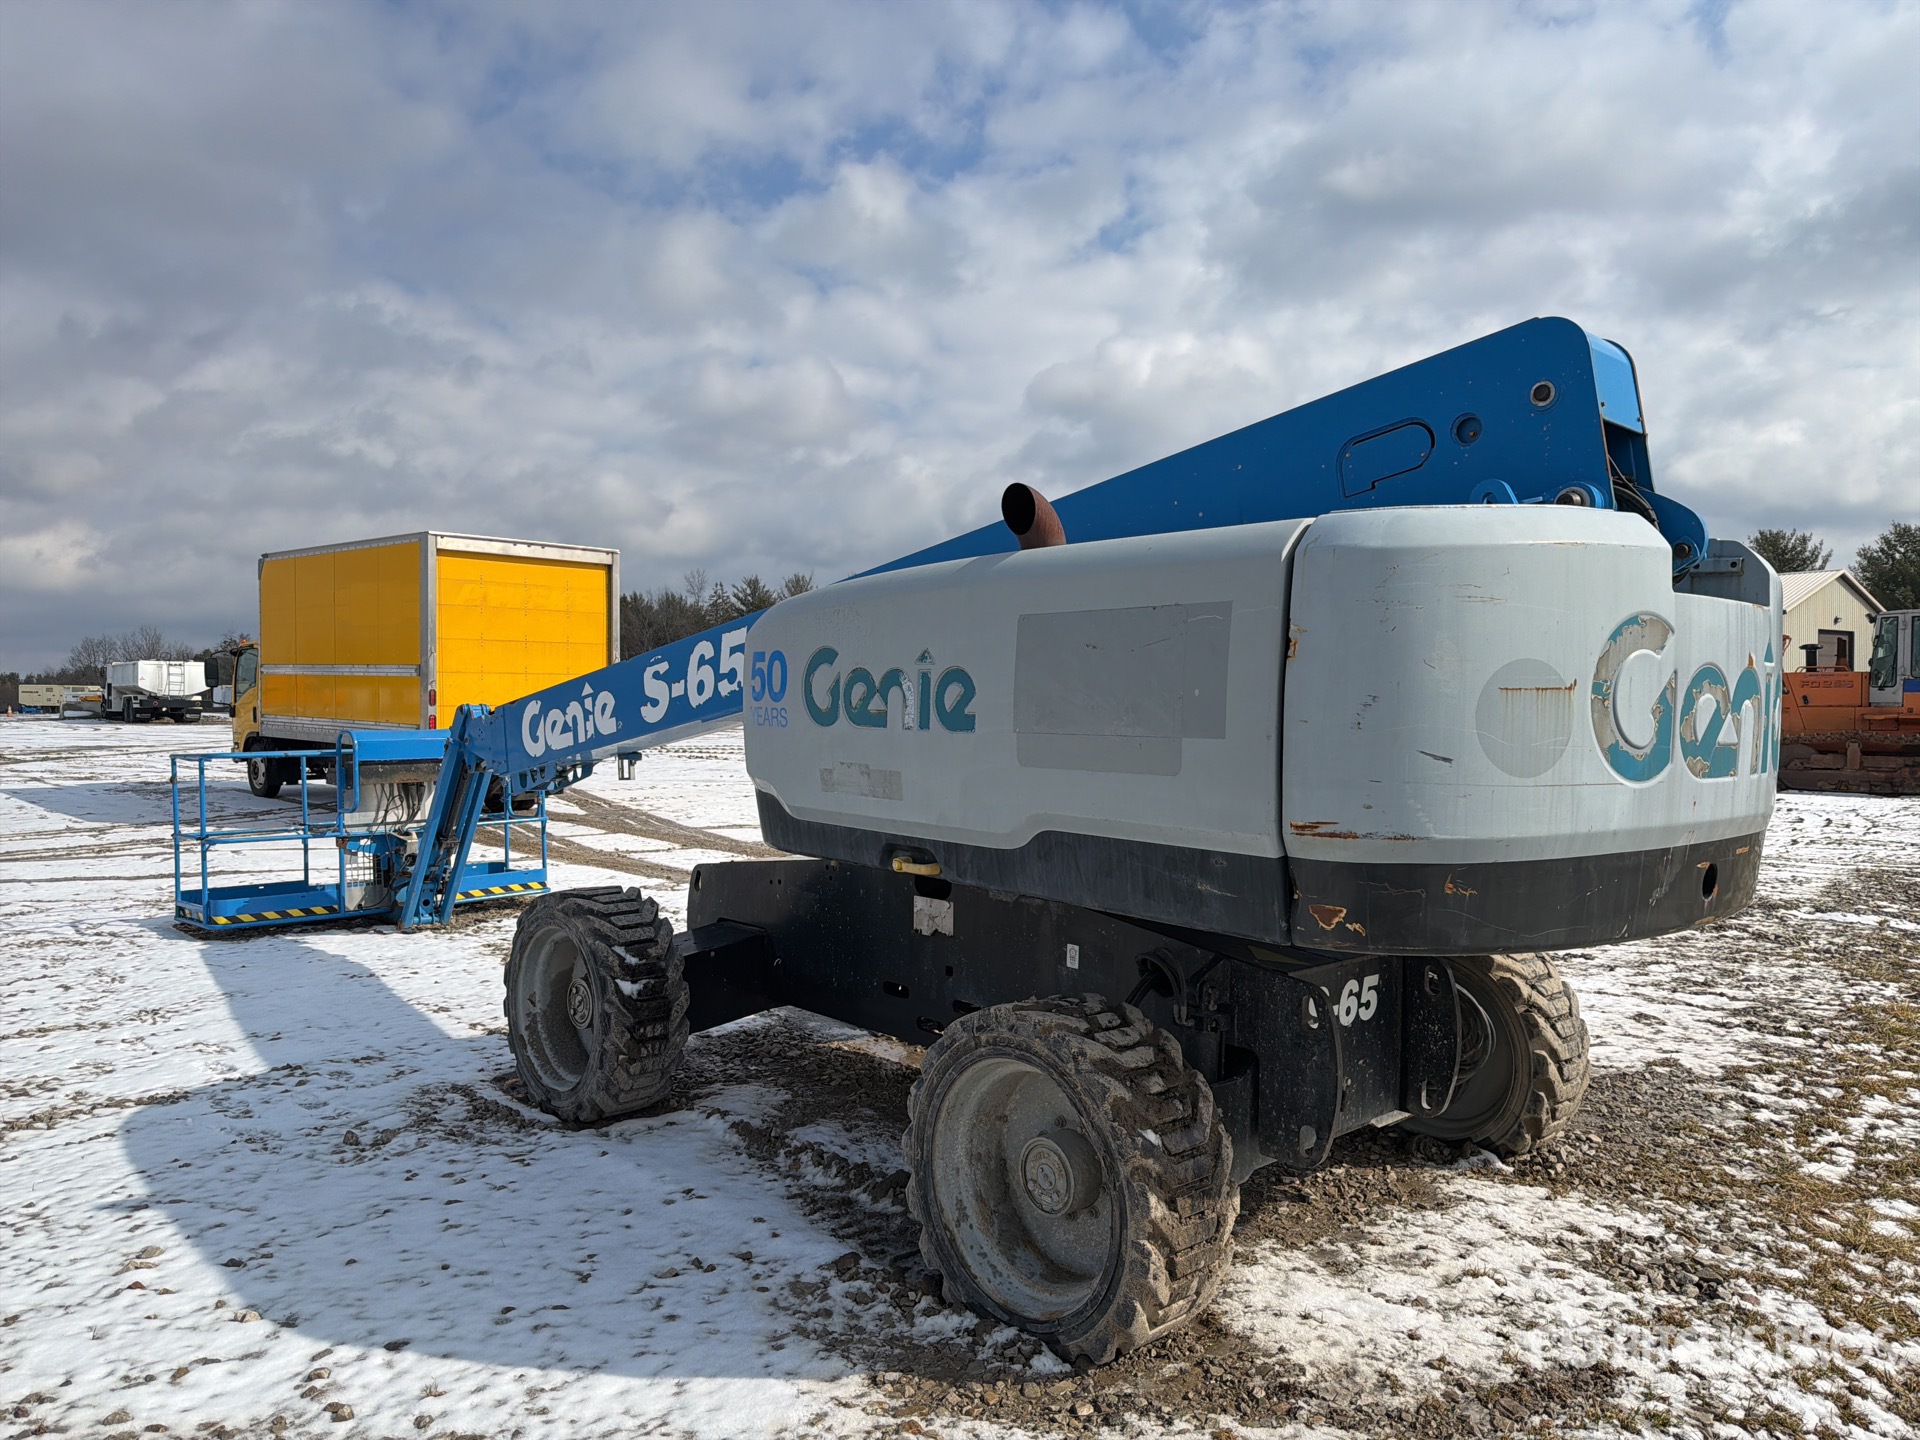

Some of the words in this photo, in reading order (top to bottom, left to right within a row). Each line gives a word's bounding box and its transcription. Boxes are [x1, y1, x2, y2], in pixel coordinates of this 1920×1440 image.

[641, 626, 747, 723] S-65
[751, 650, 788, 703] 50
[803, 647, 976, 732] Genie
[522, 682, 617, 757] Genie
[751, 706, 788, 728] YEARS
